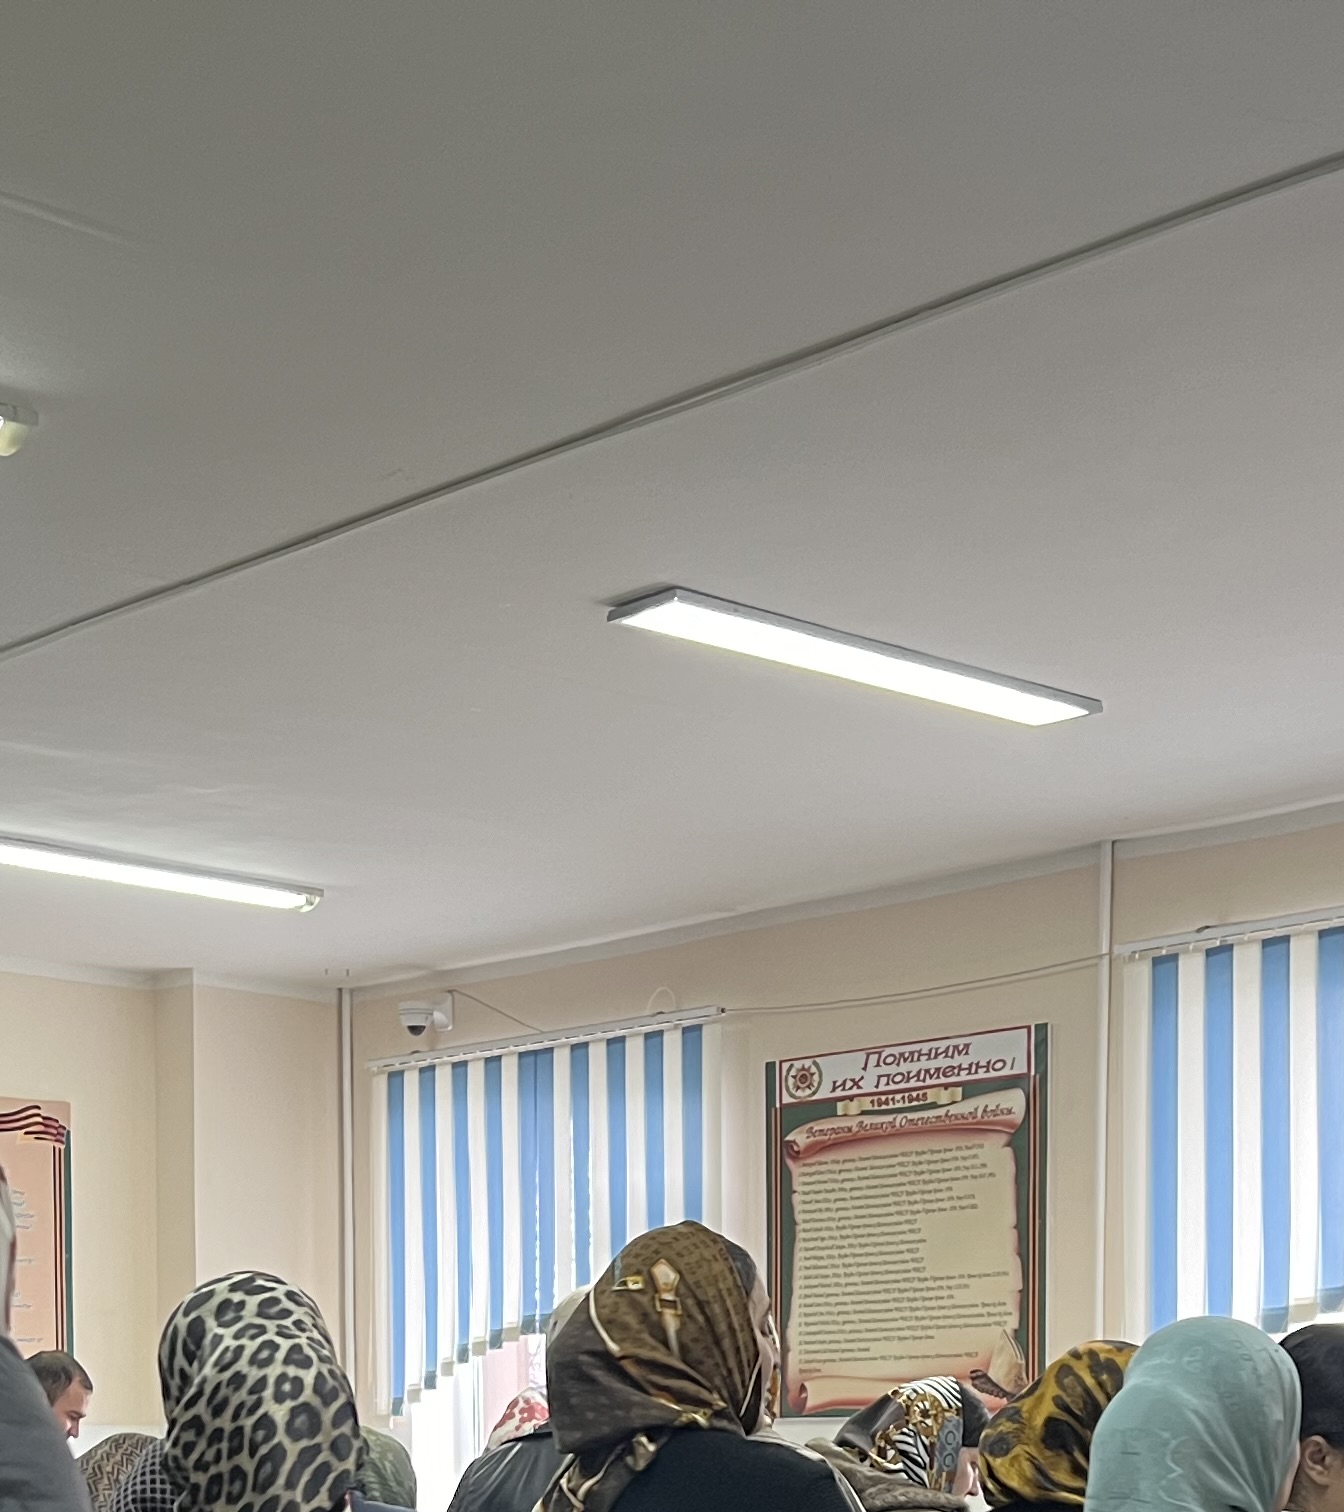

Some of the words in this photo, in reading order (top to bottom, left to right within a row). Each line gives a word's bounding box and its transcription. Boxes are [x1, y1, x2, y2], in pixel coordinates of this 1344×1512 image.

[861, 1042, 972, 1072] Помним
[830, 1075, 865, 1094] их
[870, 1091, 929, 1109] 1941-1945
